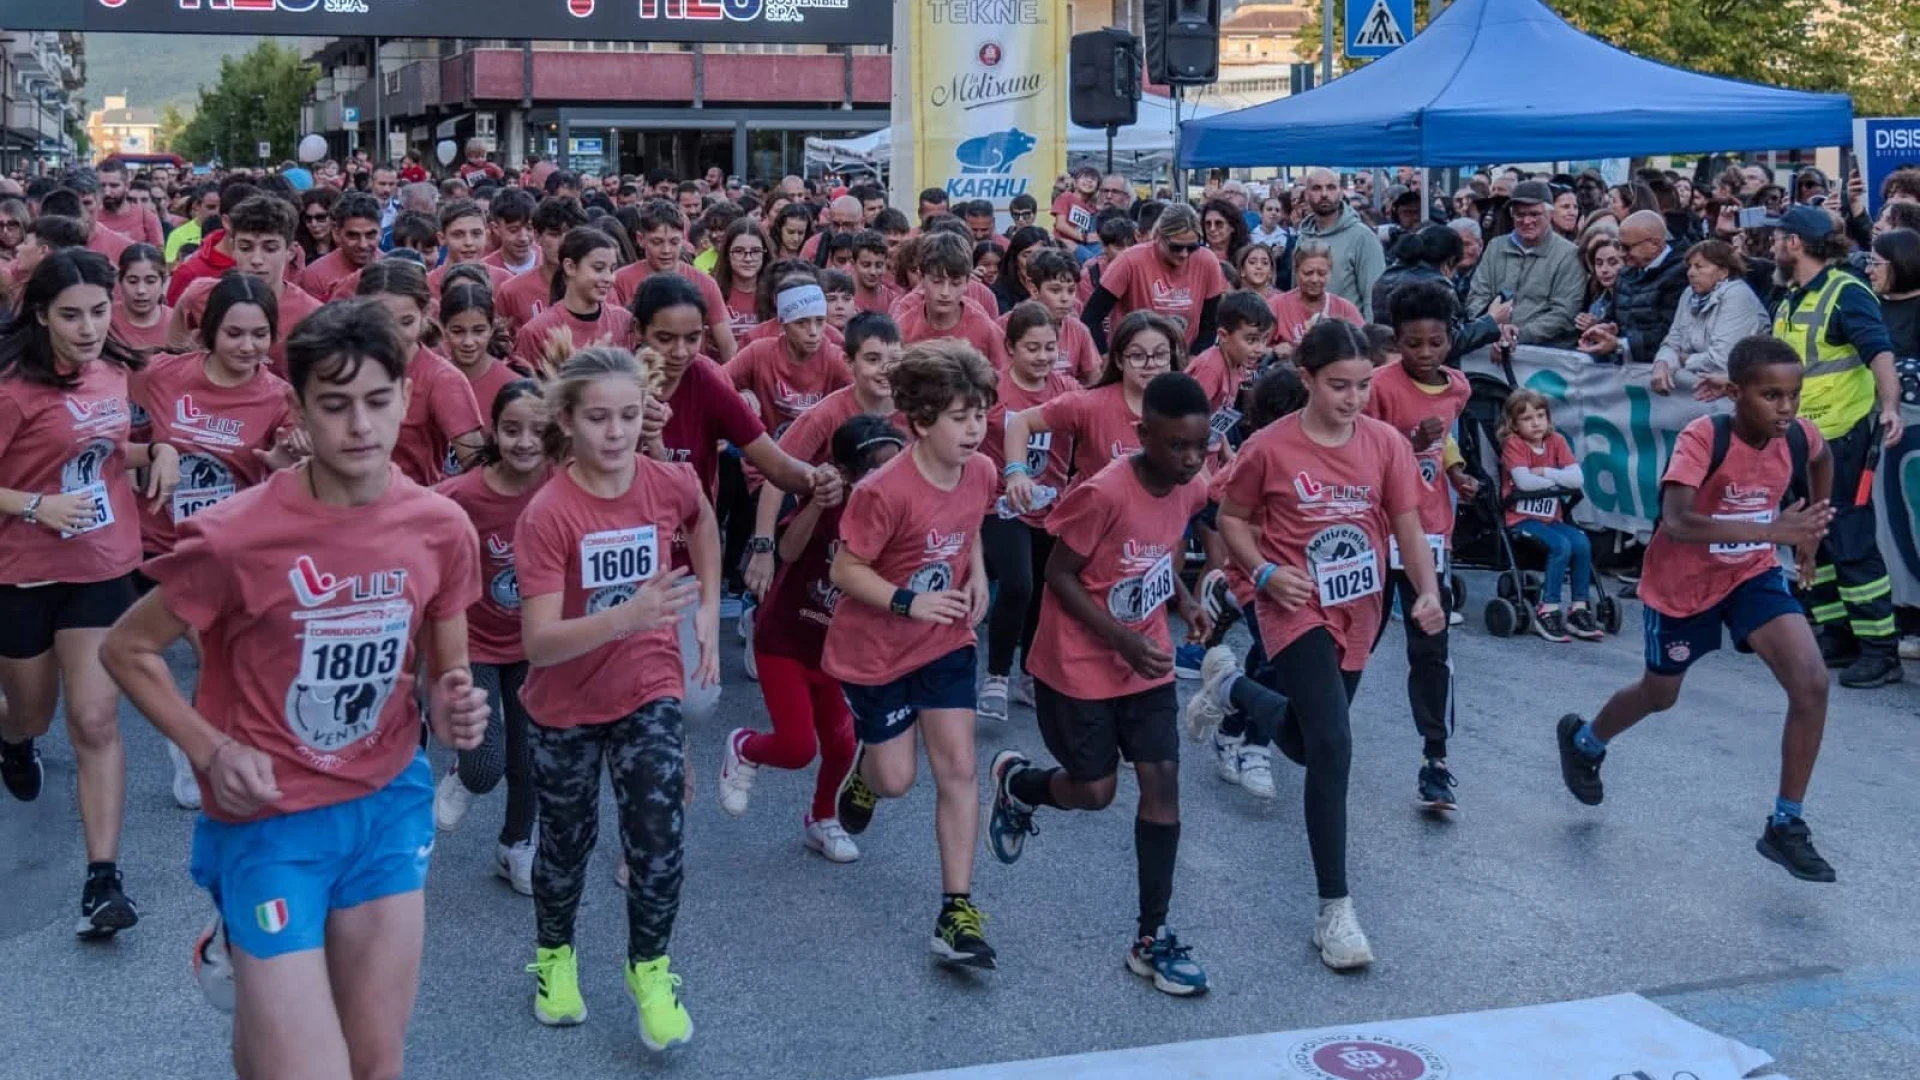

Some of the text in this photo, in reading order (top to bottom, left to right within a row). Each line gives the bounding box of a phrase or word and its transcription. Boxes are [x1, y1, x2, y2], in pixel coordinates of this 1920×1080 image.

[765, 5, 804, 21] S.P.A.
[928, 0, 1038, 24] TEKNE
[931, 72, 1044, 107] Molisana
[946, 178, 1027, 198] KARHU
[206, 417, 245, 435] LILT
[1331, 485, 1371, 500] LILT
[588, 545, 652, 583] 1606
[353, 569, 408, 601] LILT
[1143, 569, 1171, 613] 2348
[1324, 566, 1374, 601] 1029
[312, 637, 400, 681] 1803
